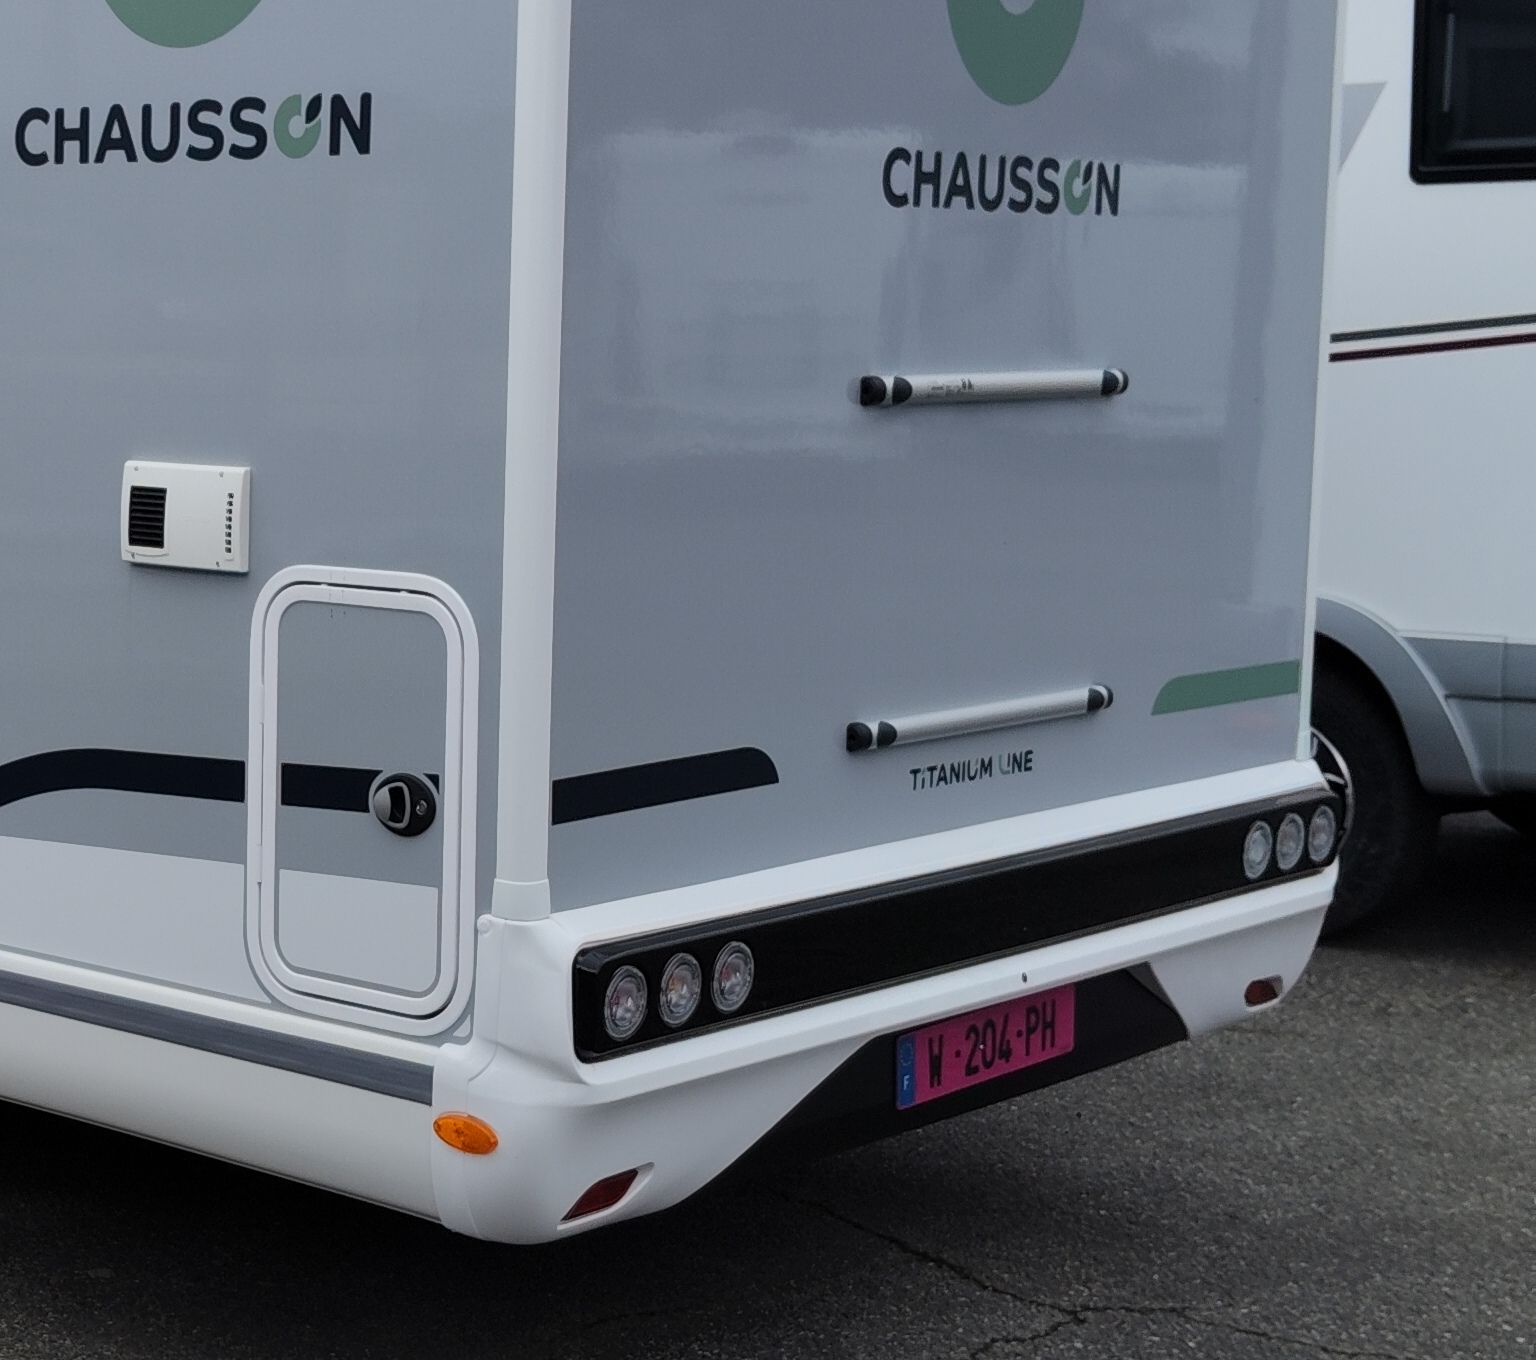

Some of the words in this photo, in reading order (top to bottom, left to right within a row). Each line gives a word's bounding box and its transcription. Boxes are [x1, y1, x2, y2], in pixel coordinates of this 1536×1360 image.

[15, 92, 372, 167] CHAUSSON
[882, 147, 1121, 216] CHAUSSON
[909, 755, 993, 791] TITANIUM
[998, 749, 1034, 776] LINE
[902, 1074, 912, 1091] F
